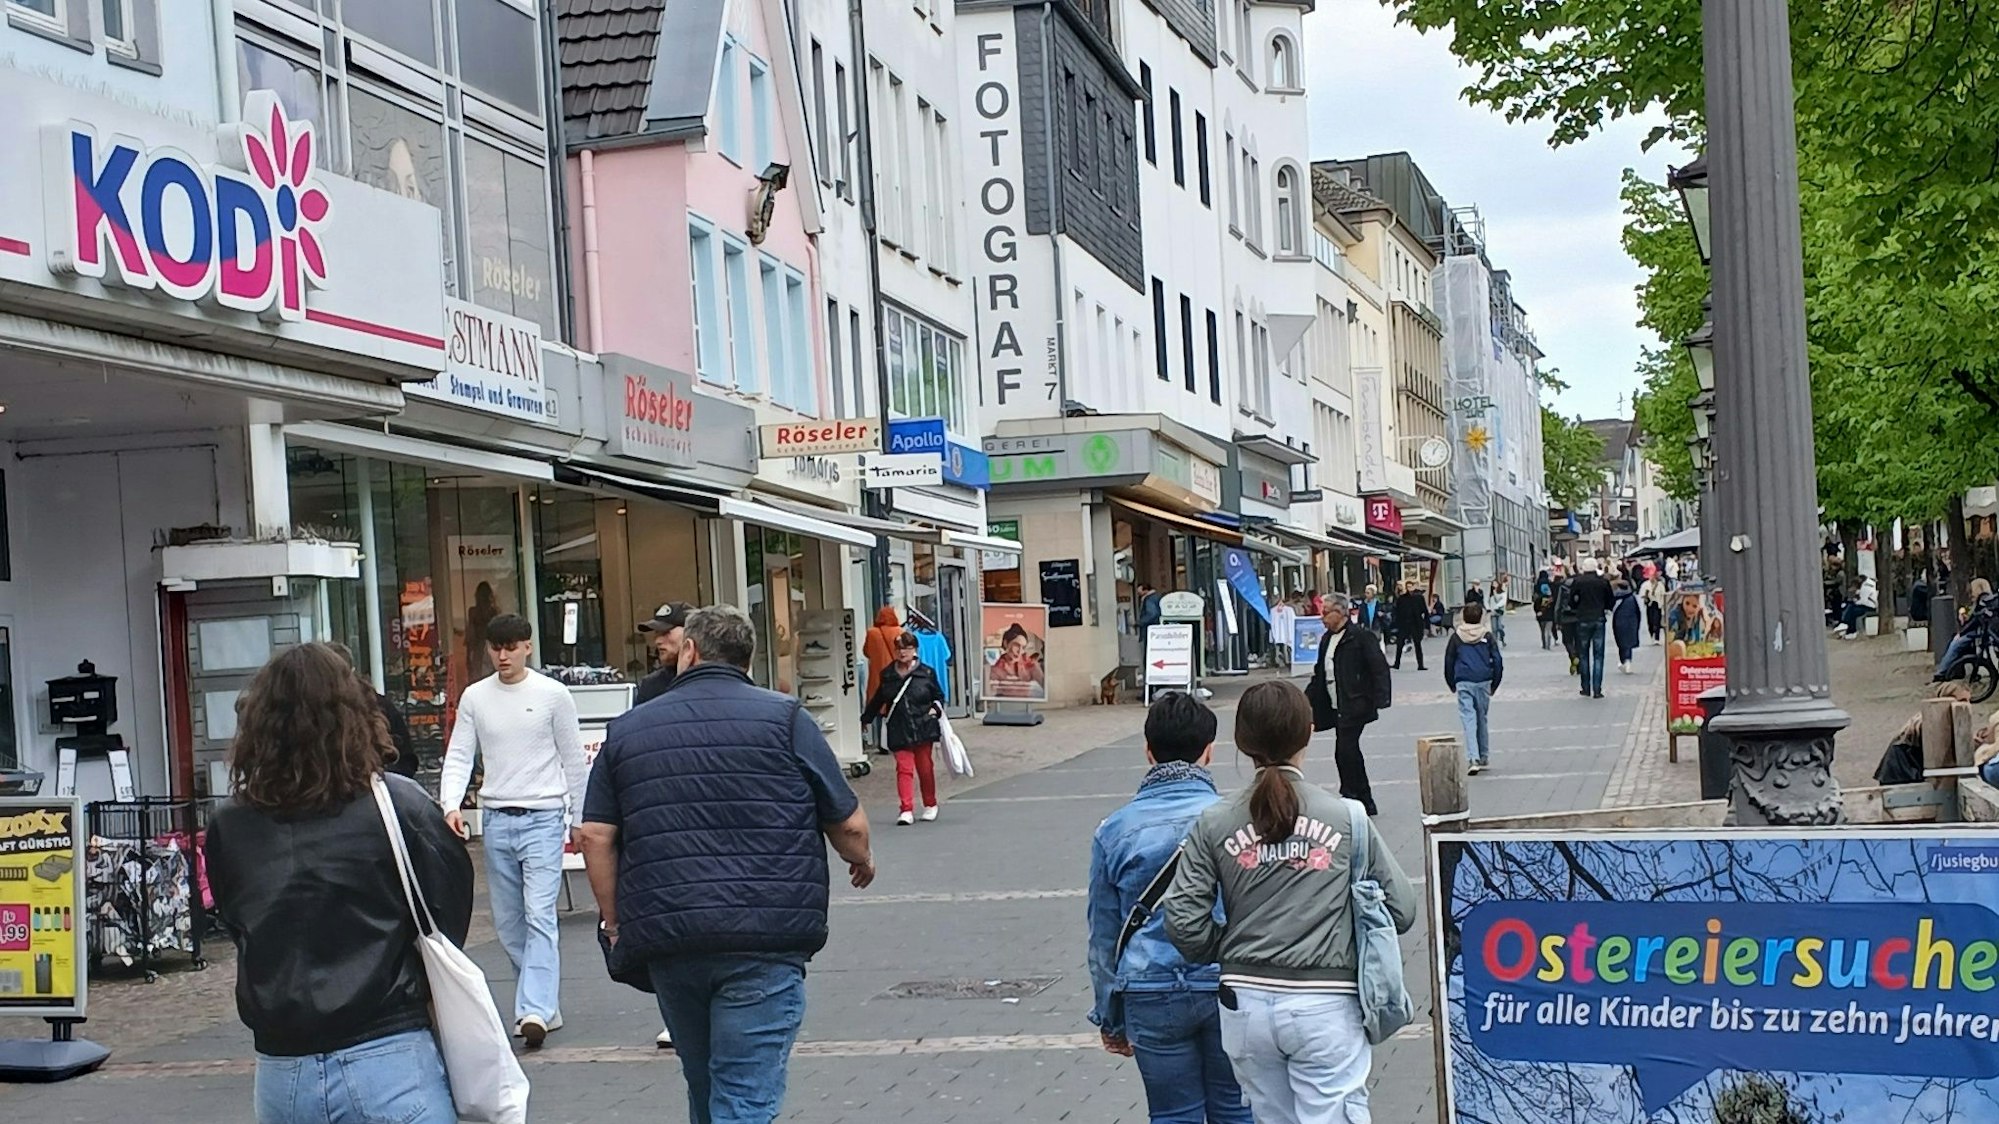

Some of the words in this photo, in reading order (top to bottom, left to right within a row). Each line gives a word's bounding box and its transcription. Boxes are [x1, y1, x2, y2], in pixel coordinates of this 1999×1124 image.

[976, 34, 1022, 405] FOTOGRAF
[482, 256, 541, 301] Röseler
[451, 310, 539, 382] STMANN
[1046, 337, 1057, 375] MARKT
[488, 384, 503, 405] und
[507, 389, 543, 415] Gravuren
[624, 373, 692, 432] Röseler
[1044, 382, 1057, 400] 7
[777, 421, 867, 444] Röseler
[891, 431, 943, 451] Apollo
[1372, 502, 1389, 521] T
[18, 836, 71, 850] GÜNSTIG
[1224, 815, 1343, 856] CALRNIA
[1481, 917, 1999, 990] Ostereiersuche
[1480, 991, 1530, 1032] für
[1537, 994, 1589, 1025] alle
[1599, 997, 1701, 1029] Kinder
[1710, 999, 1755, 1030] bis
[1762, 1008, 1800, 1032] zu
[1809, 1003, 1888, 1034] zehn
